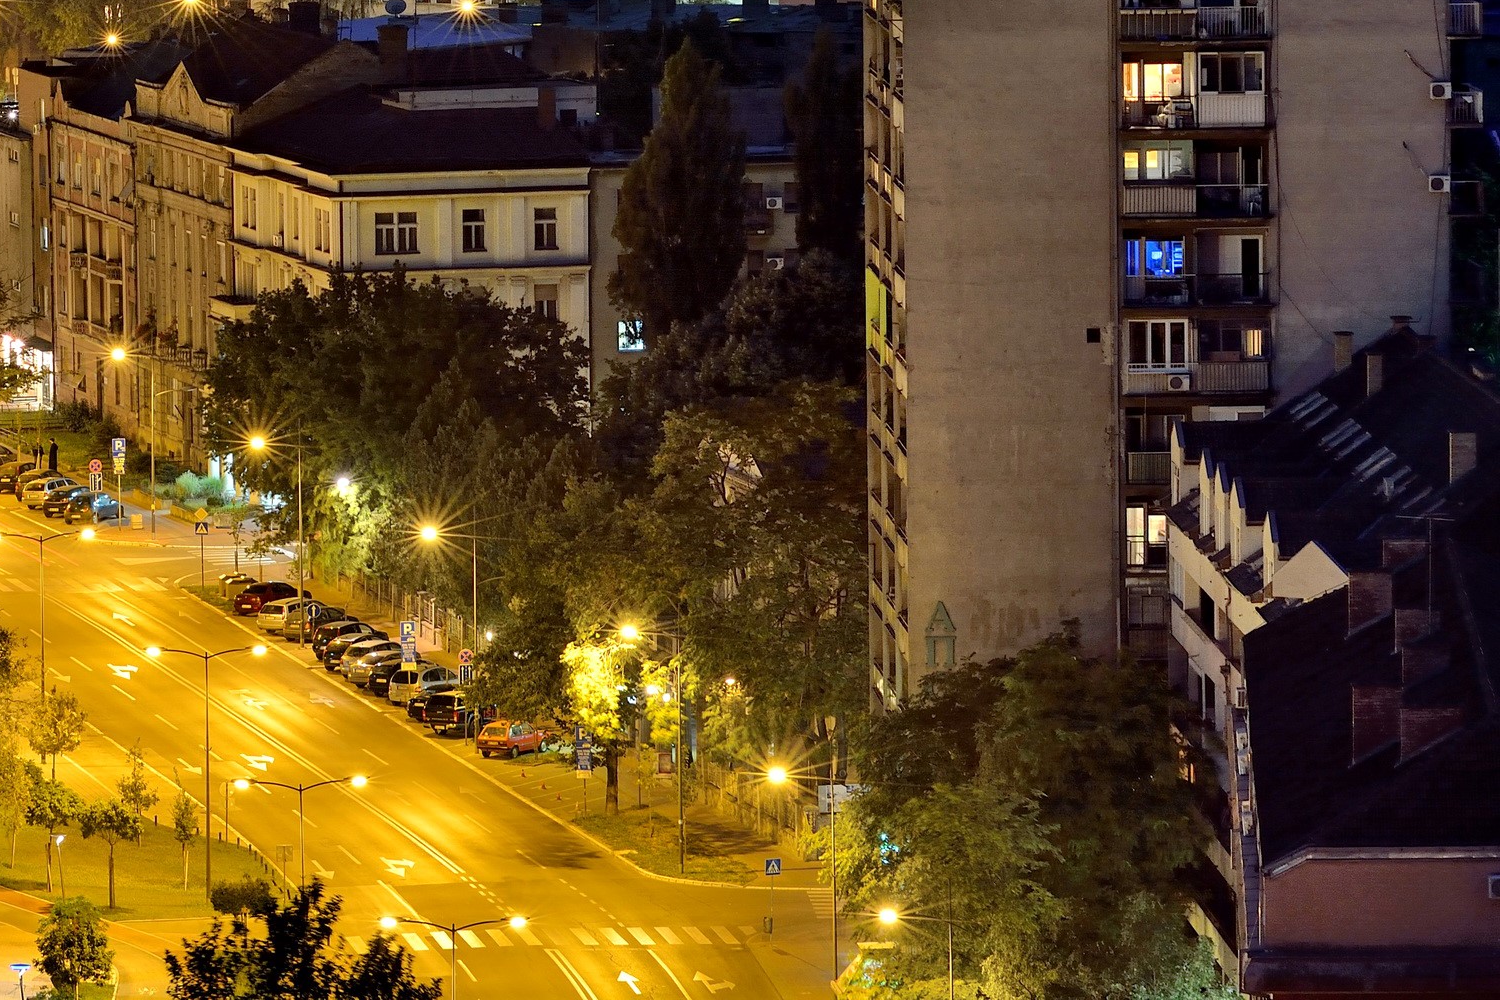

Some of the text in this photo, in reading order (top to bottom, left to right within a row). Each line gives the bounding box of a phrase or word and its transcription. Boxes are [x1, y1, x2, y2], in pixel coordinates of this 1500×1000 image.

[115, 440, 124, 450] P
[404, 624, 412, 635] P
[578, 728, 587, 740] P
